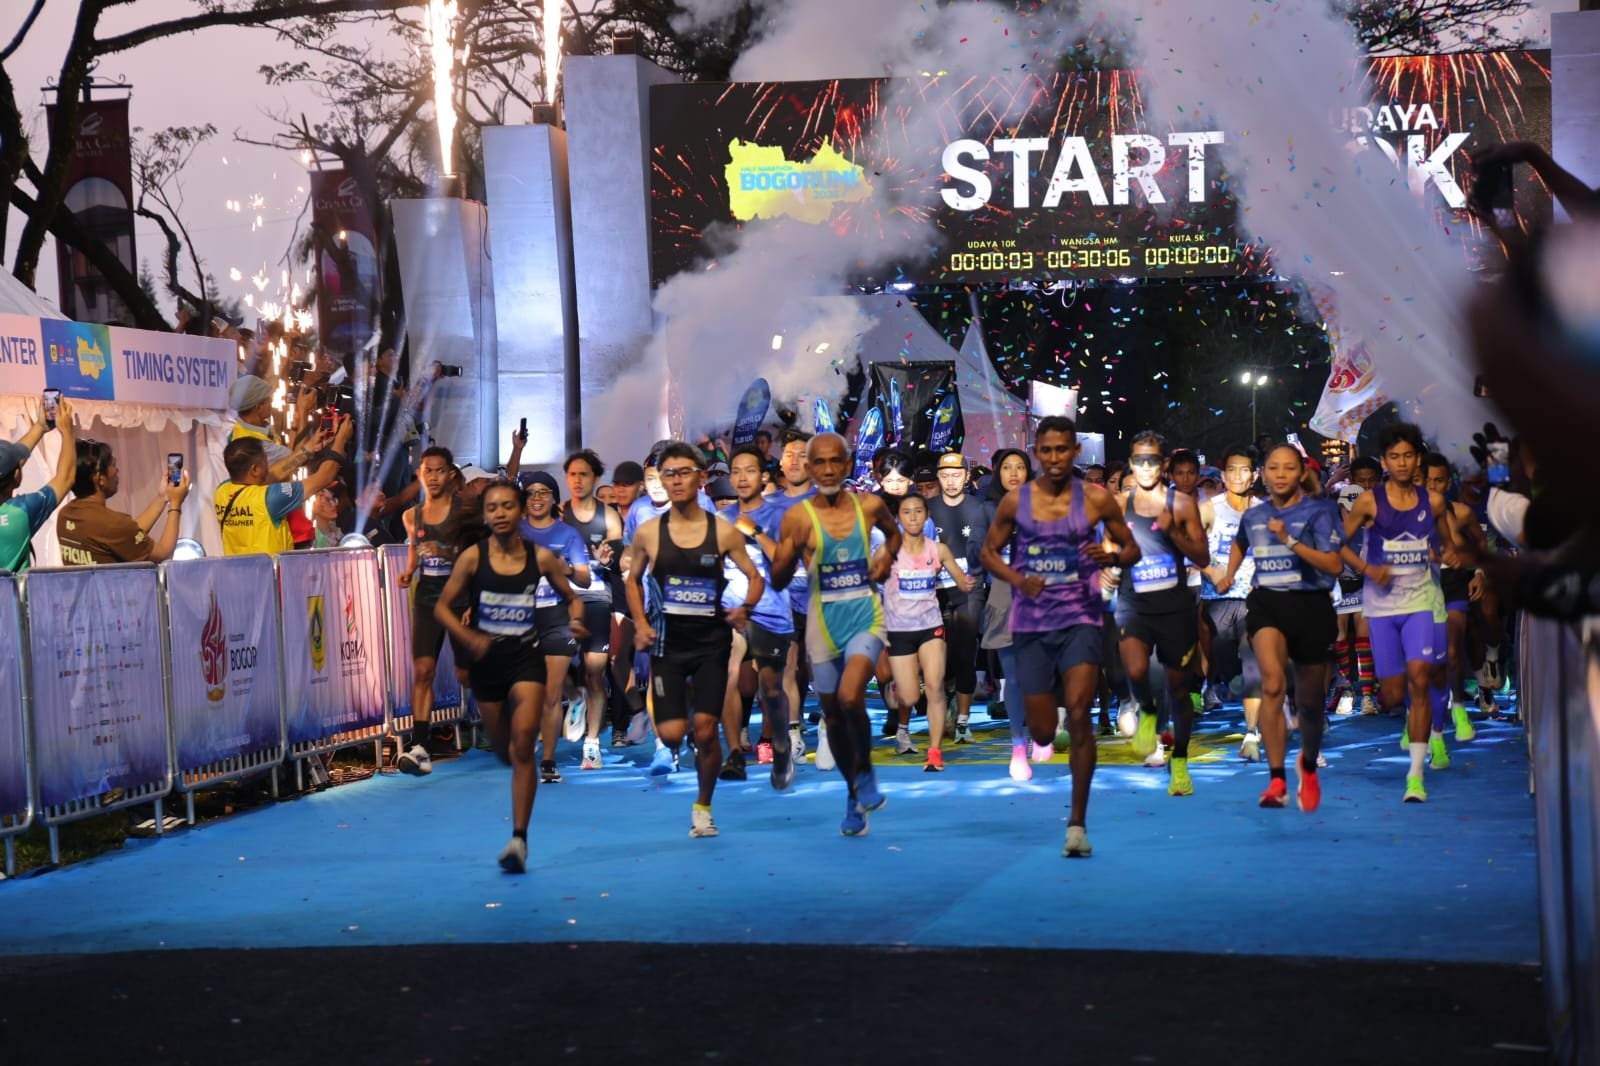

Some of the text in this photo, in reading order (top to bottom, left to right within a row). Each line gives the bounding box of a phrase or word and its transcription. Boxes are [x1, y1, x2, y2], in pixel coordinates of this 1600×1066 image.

[1329, 104, 1438, 132] UDAYA
[941, 131, 1225, 212] START
[967, 240, 1017, 249] UDAYA 10K
[1060, 237, 1118, 246] WANGSA HM
[1169, 234, 1205, 243] KUTA 5K
[951, 252, 1033, 271] 00:00:03
[1048, 250, 1131, 269] 00:30:06
[1145, 246, 1230, 266] 00:00:00
[0, 336, 38, 366] NTER
[122, 350, 228, 388] TIMING SYSTEM
[1035, 559, 1066, 572] 3015
[1261, 559, 1292, 571] 4030
[1393, 553, 1422, 564] 3034
[906, 580, 927, 590] 3124
[674, 590, 707, 603] 3052
[230, 646, 257, 671] BOGOR
